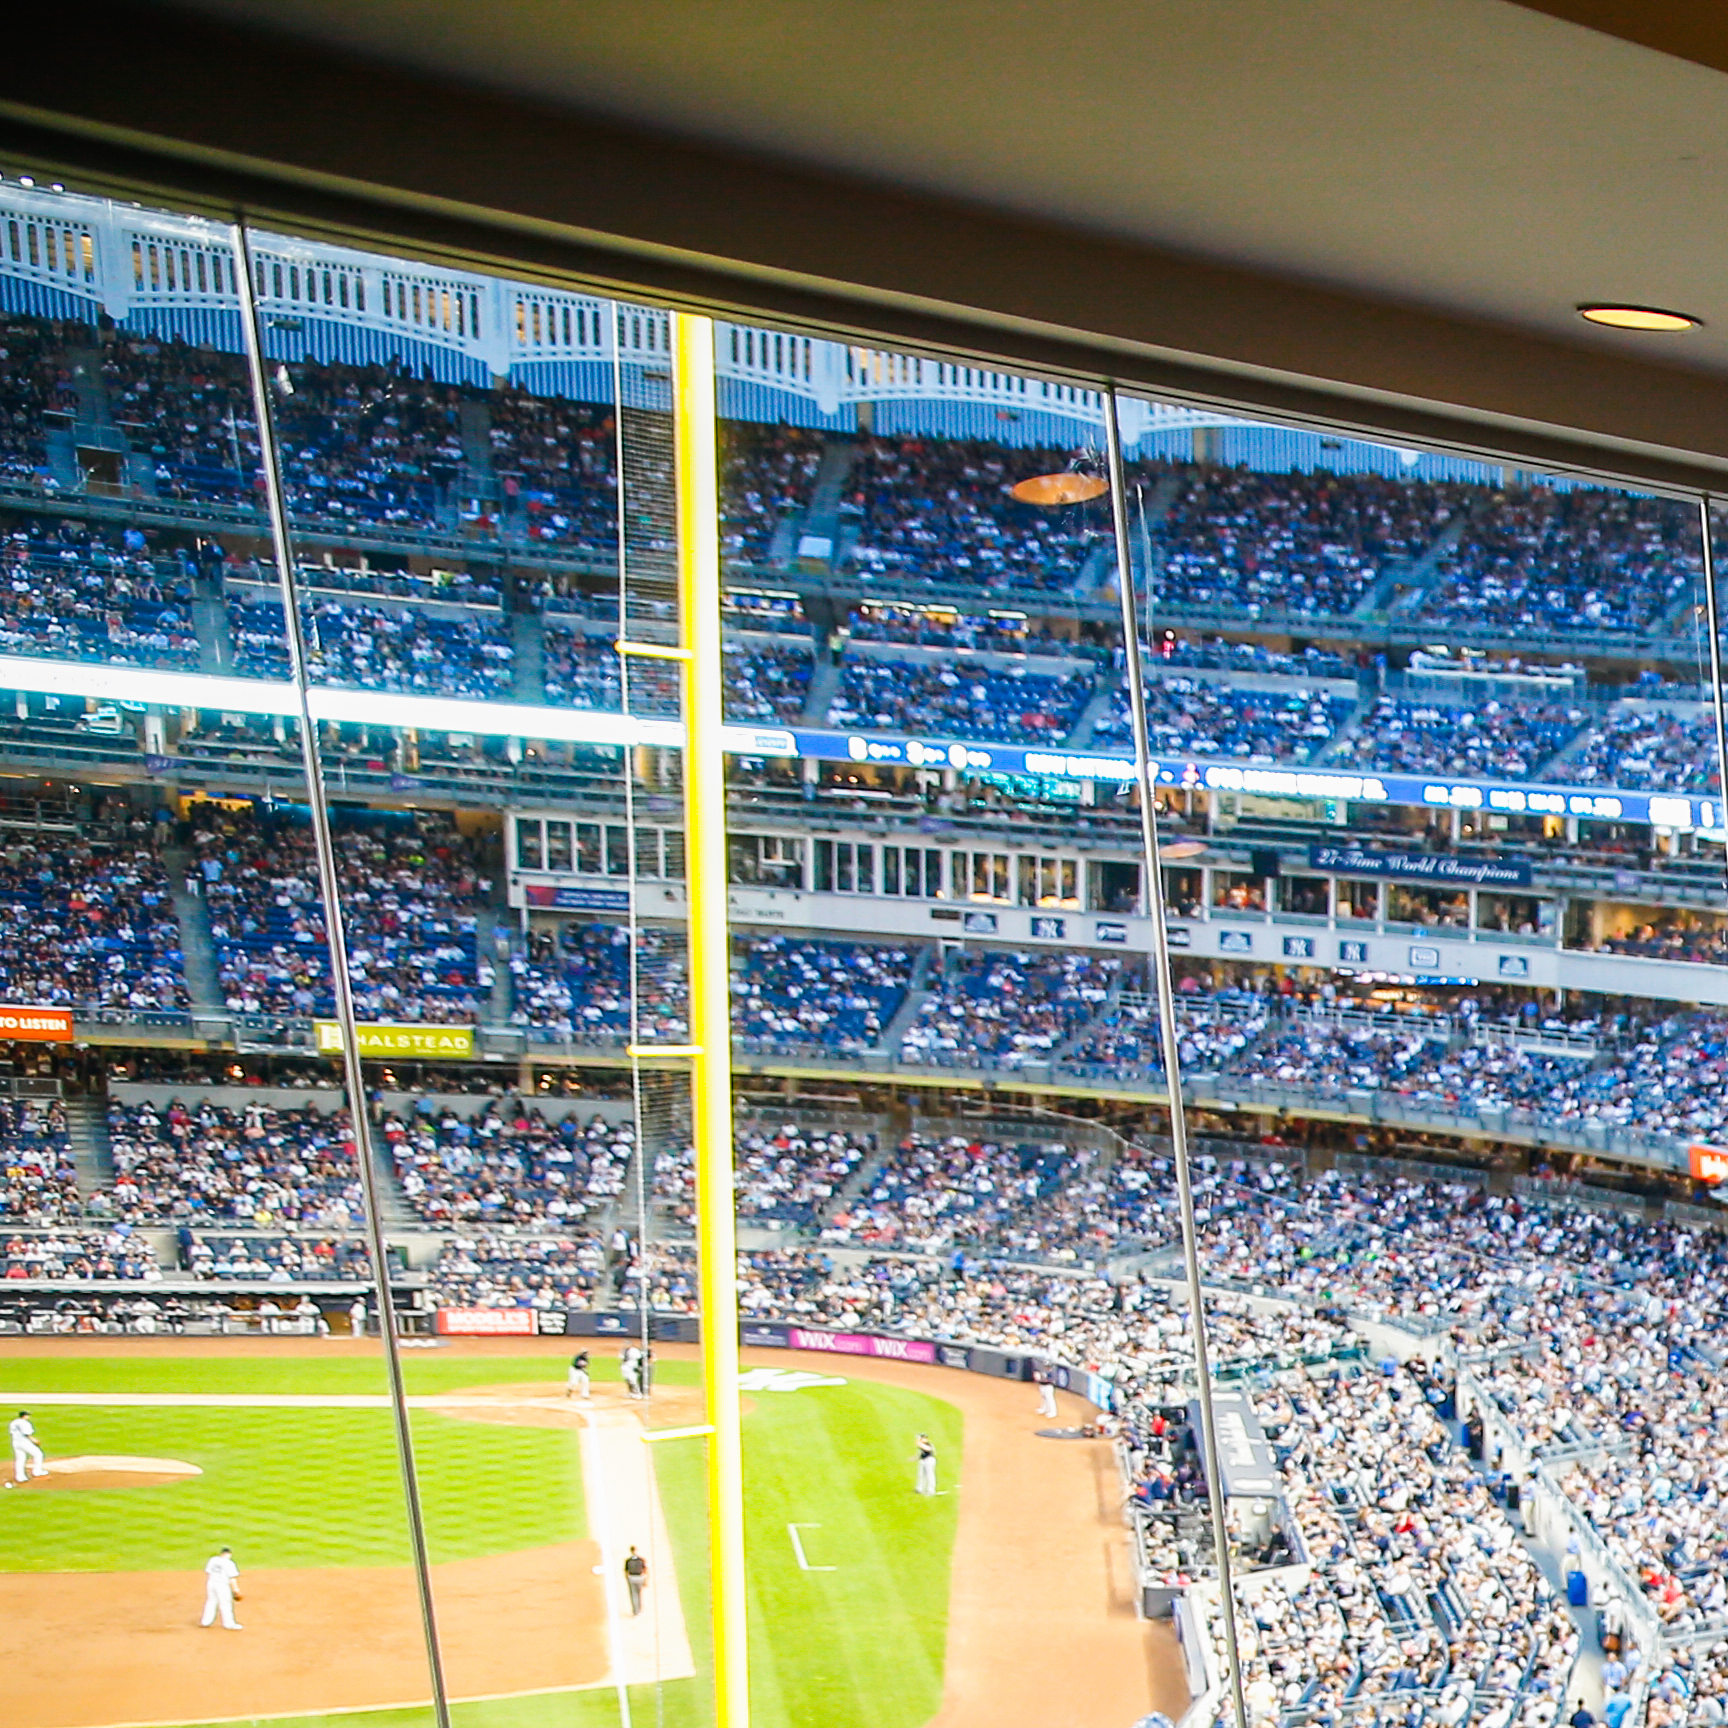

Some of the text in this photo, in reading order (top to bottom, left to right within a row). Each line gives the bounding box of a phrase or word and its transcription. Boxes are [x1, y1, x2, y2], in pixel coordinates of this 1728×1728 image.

[1316, 849, 1521, 882] 27-Time World Champions
[20, 1017, 68, 1031] LISTEN
[357, 1034, 469, 1049] HALSTEAD
